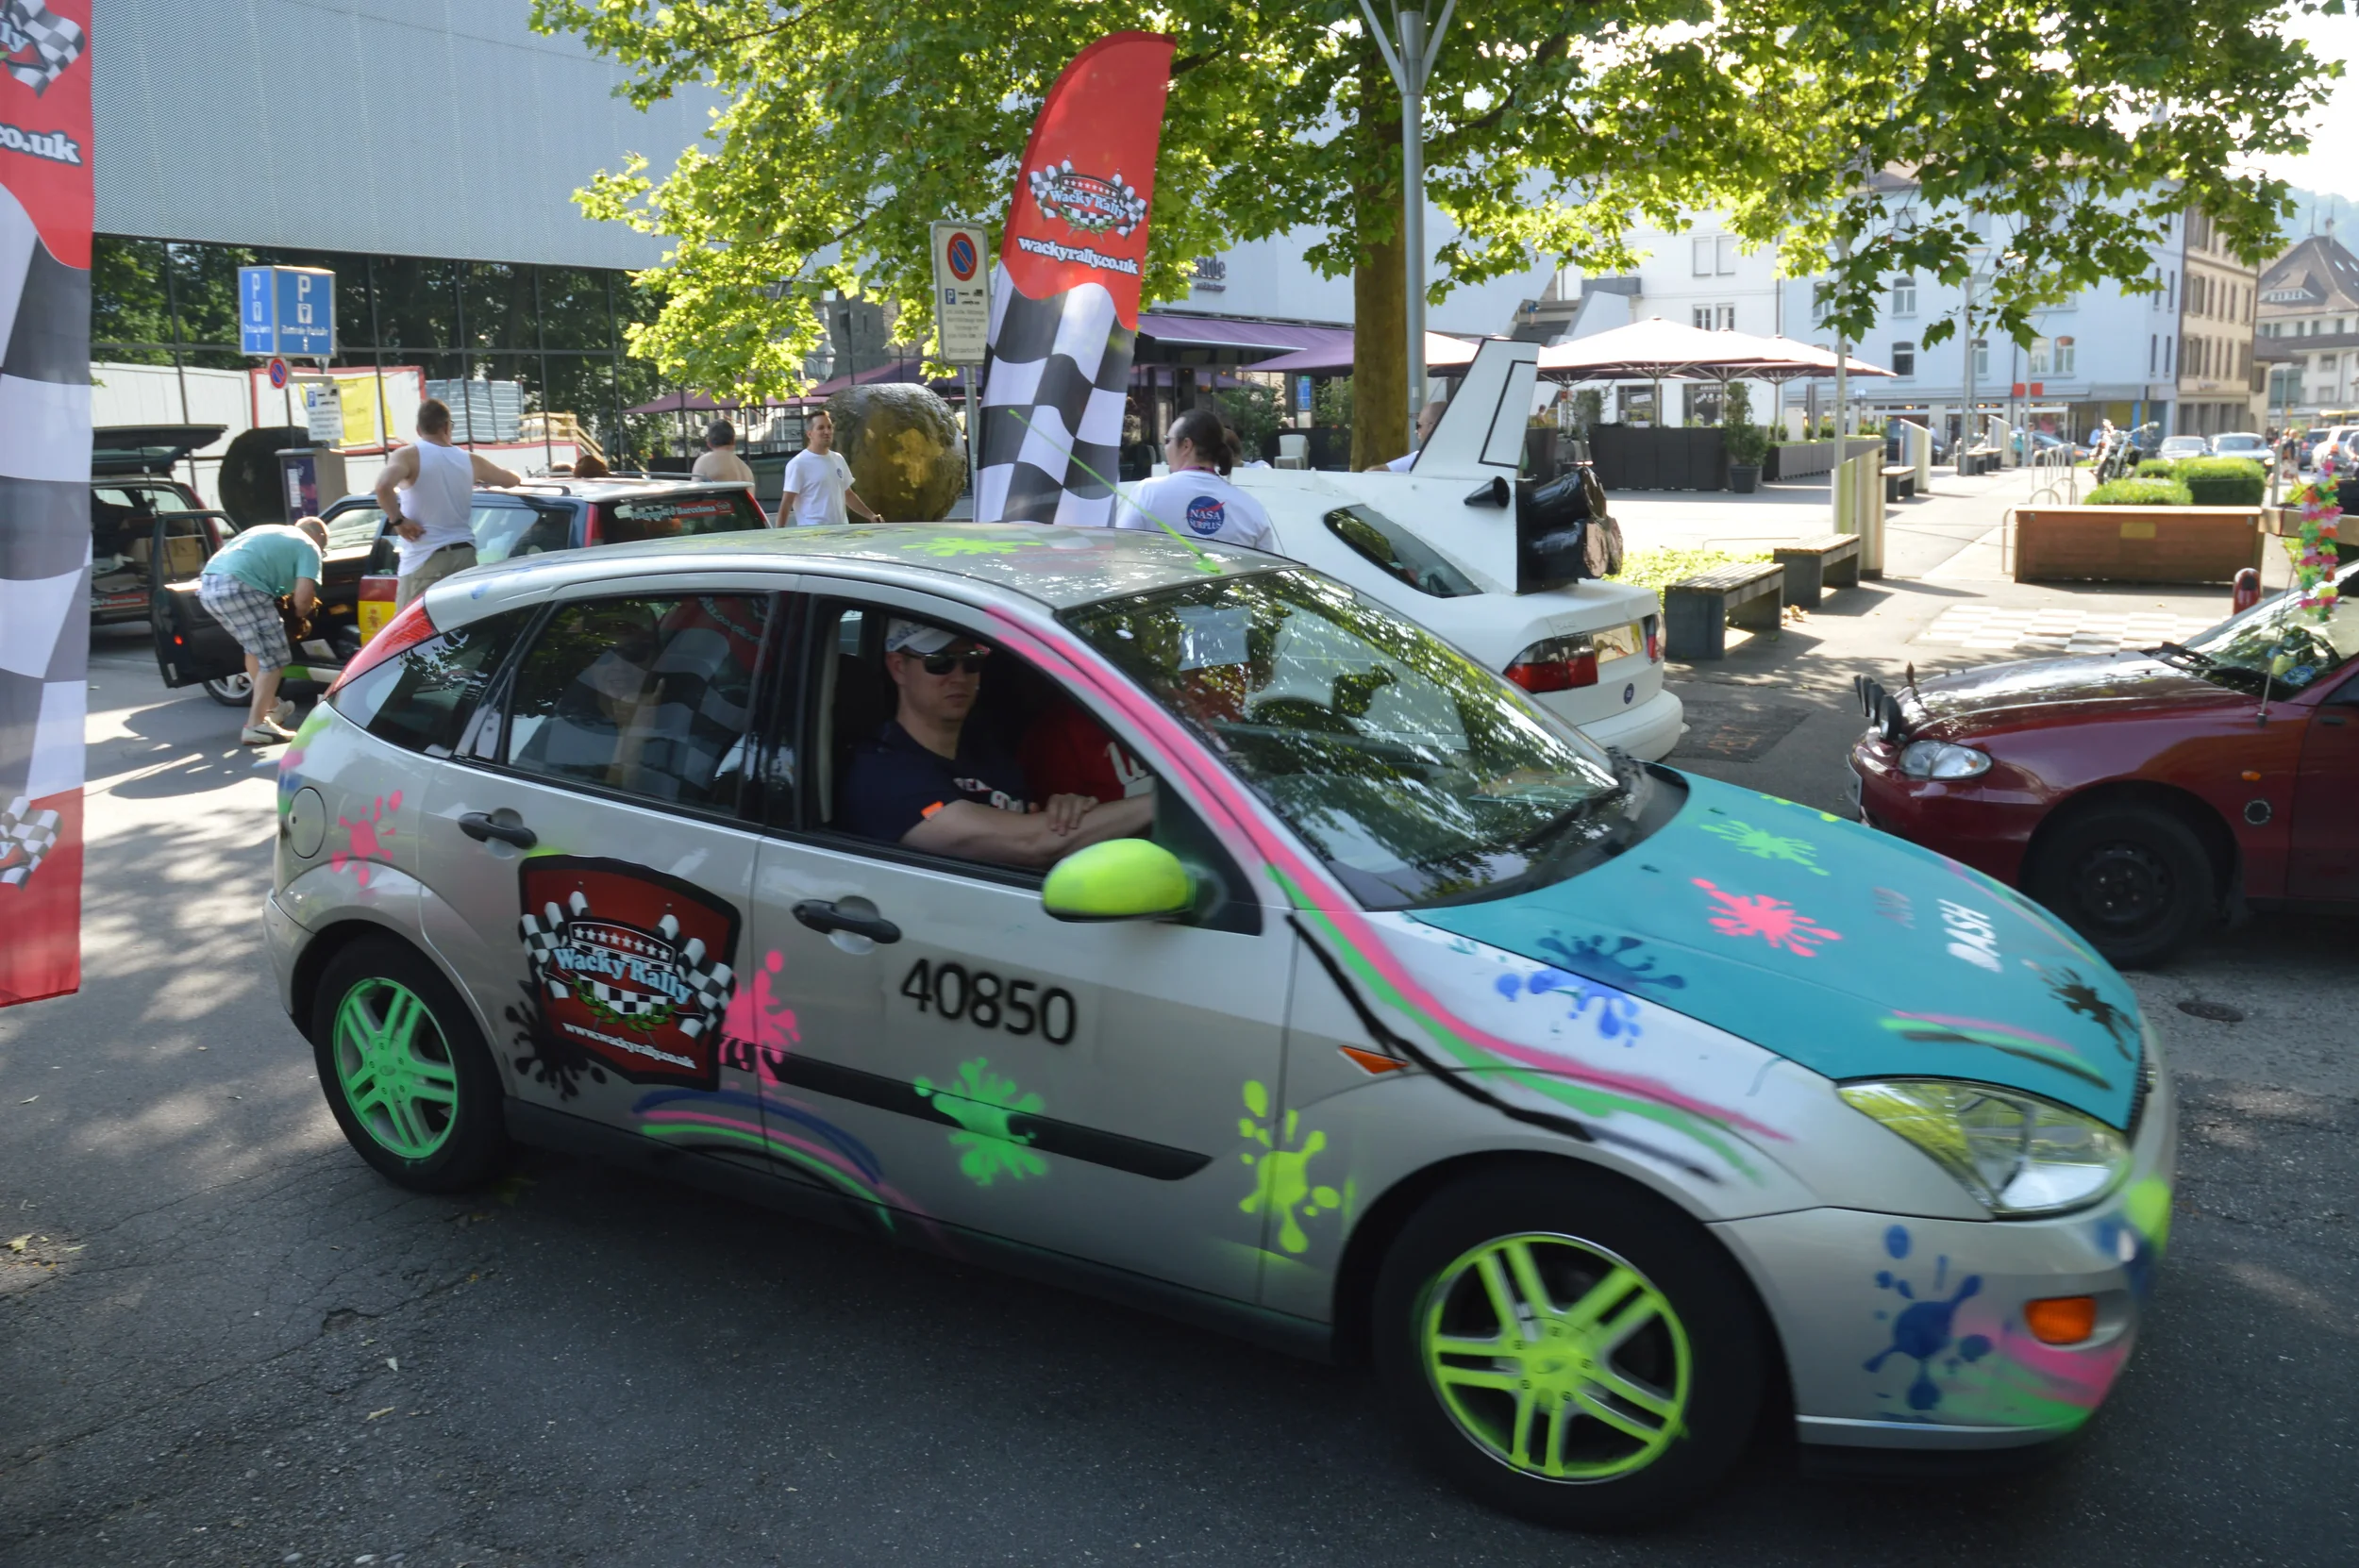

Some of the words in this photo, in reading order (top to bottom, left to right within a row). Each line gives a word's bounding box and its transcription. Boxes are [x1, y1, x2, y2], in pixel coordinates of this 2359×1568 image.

[1048, 189, 1095, 207] Wacky
[1095, 193, 1127, 220] Rally
[1017, 238, 1139, 275] wackyrally.co.uk
[252, 273, 260, 300] P
[297, 275, 310, 302] P
[946, 290, 954, 302] P
[1190, 509, 1222, 521] NASA
[1936, 898, 2003, 973] DASH
[553, 946, 627, 980] Wacky
[629, 958, 694, 1005] Rally
[900, 958, 1078, 1046] 40850
